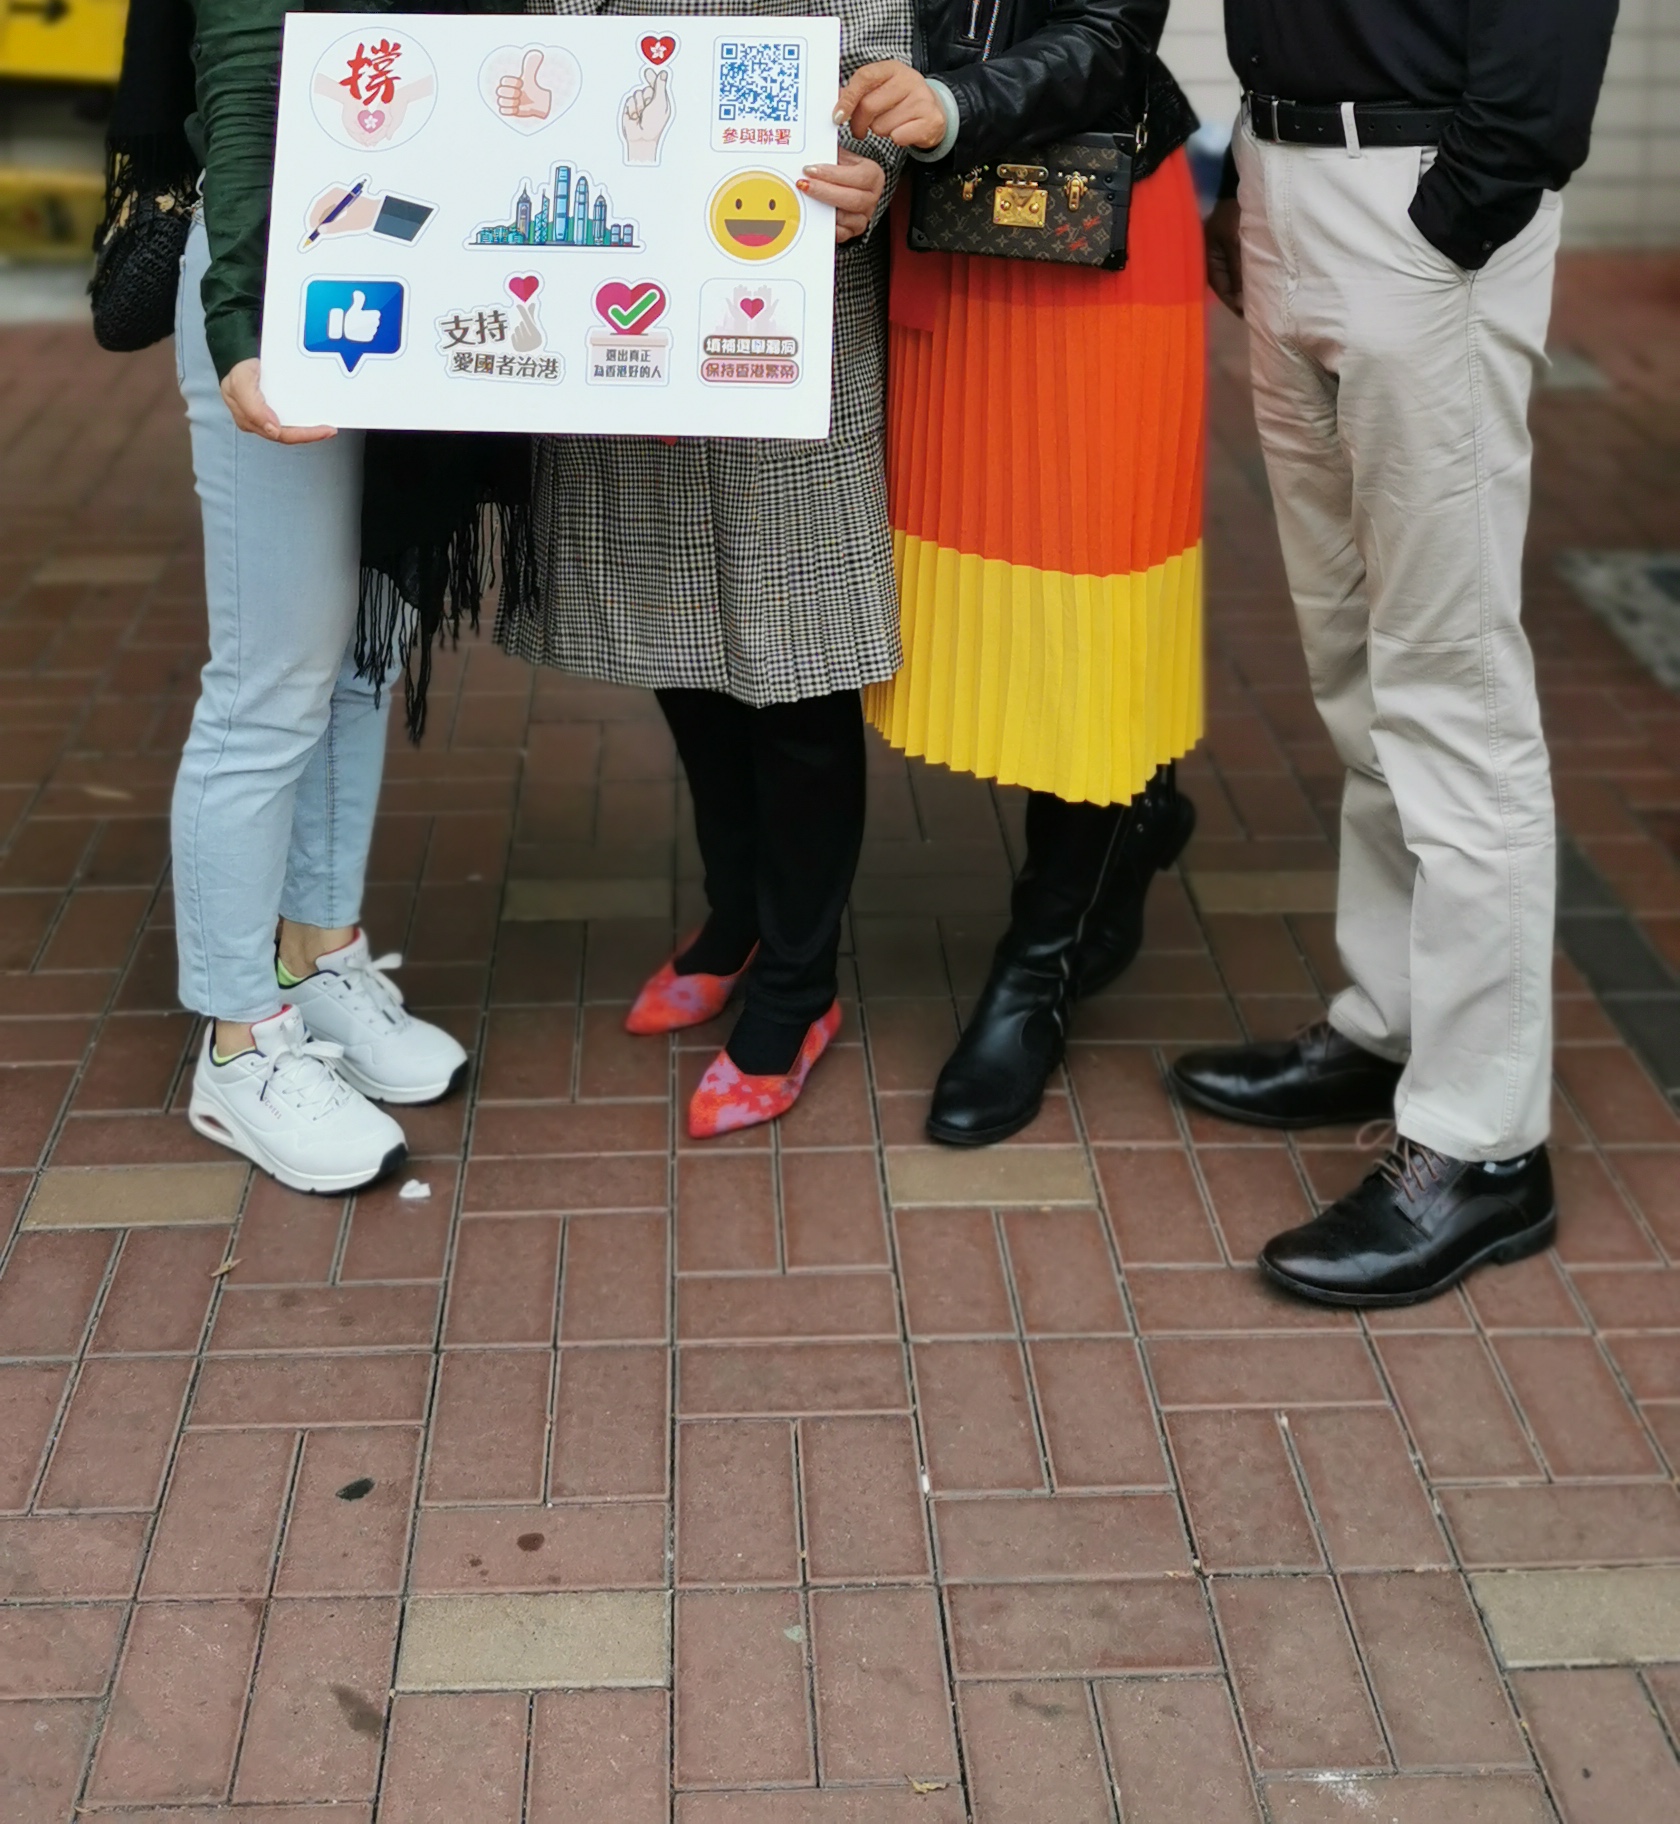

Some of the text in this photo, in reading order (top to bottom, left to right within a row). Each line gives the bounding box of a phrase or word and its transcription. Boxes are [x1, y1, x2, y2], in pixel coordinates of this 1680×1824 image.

[339, 38, 402, 106] 撐
[722, 127, 792, 146] 參與聯署
[441, 310, 508, 349] 支持
[452, 352, 559, 379] 愛國者治港
[606, 348, 652, 363] 選出真正
[705, 362, 795, 379] 保持香港繁榮
